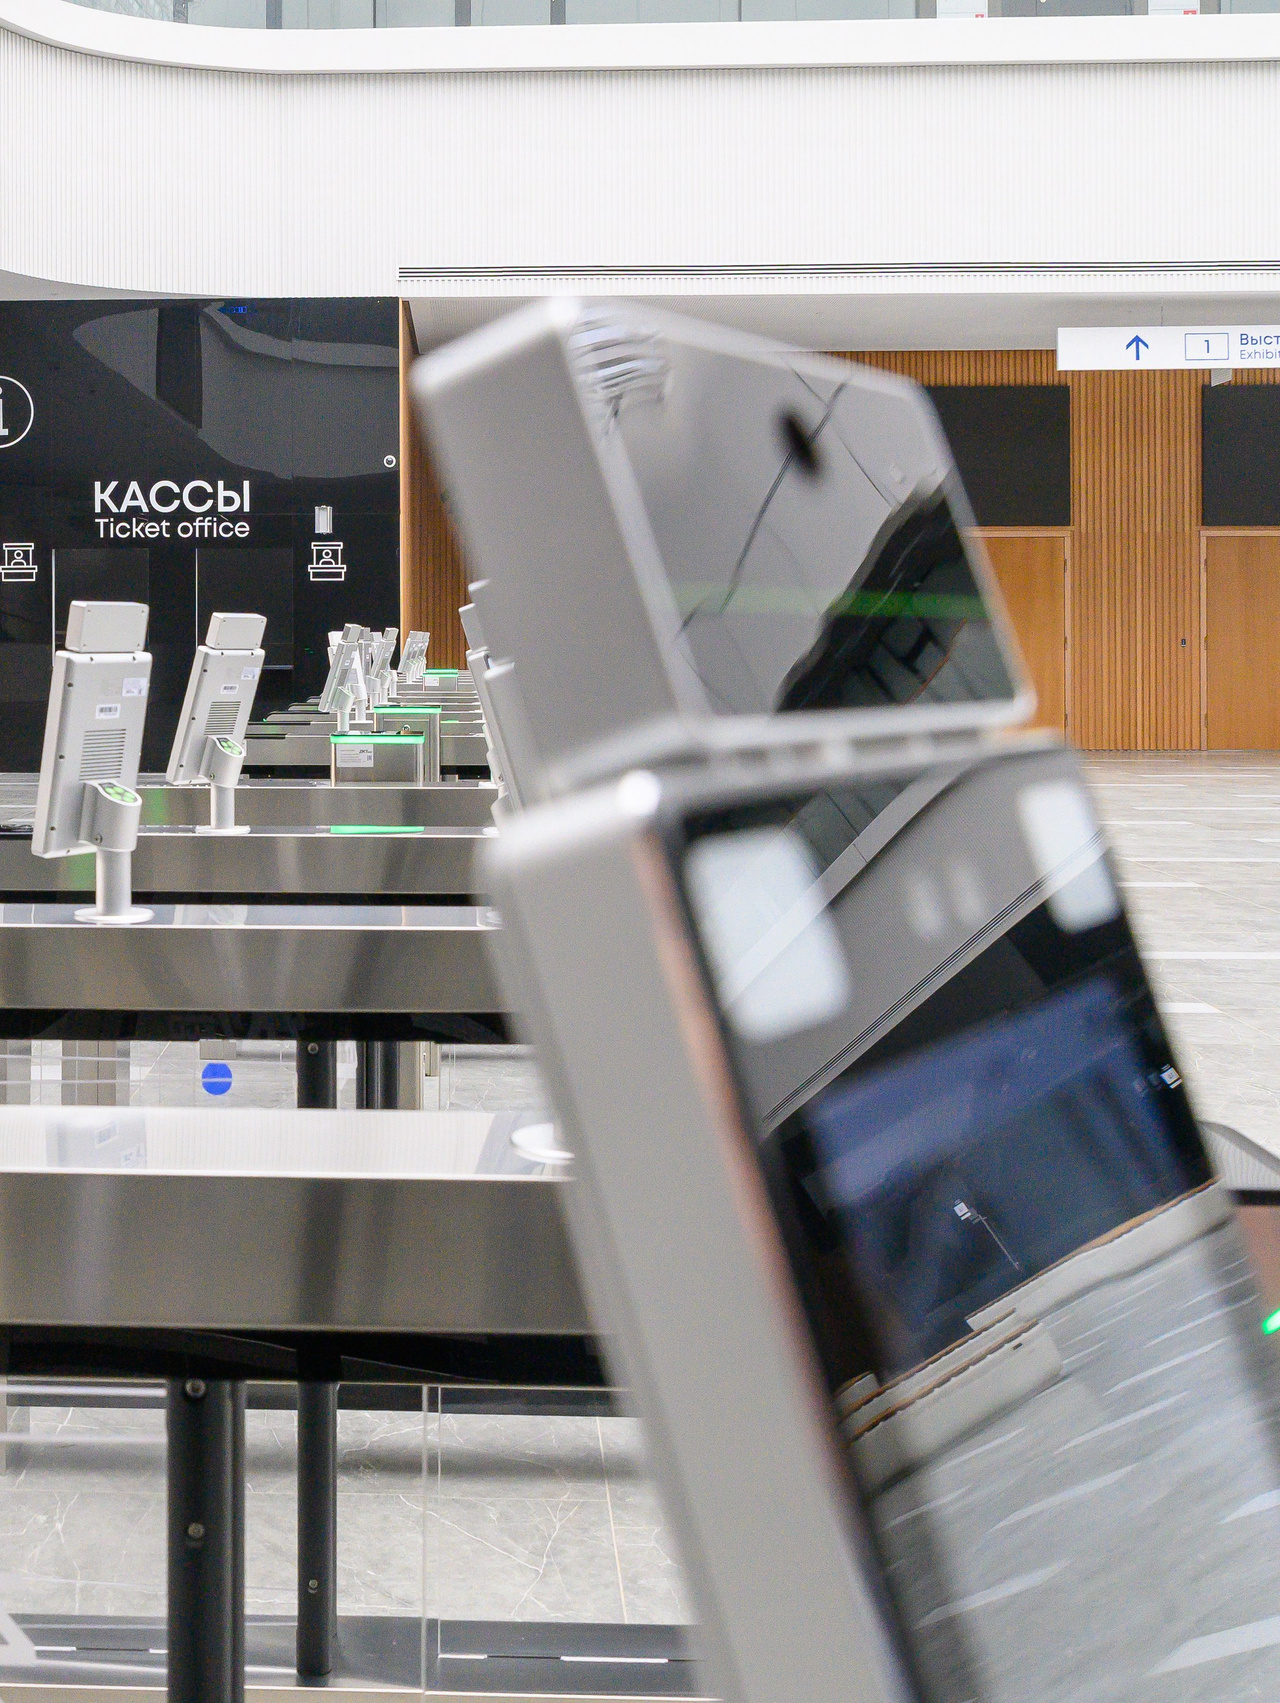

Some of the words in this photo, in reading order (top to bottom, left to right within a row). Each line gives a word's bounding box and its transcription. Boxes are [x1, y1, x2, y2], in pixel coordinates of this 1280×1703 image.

[1204, 339, 1210, 354] 1
[1239, 333, 1280, 346] Выст
[94, 480, 250, 514] КАССЫ
[95, 518, 170, 539] Ticket
[177, 517, 250, 538] office
